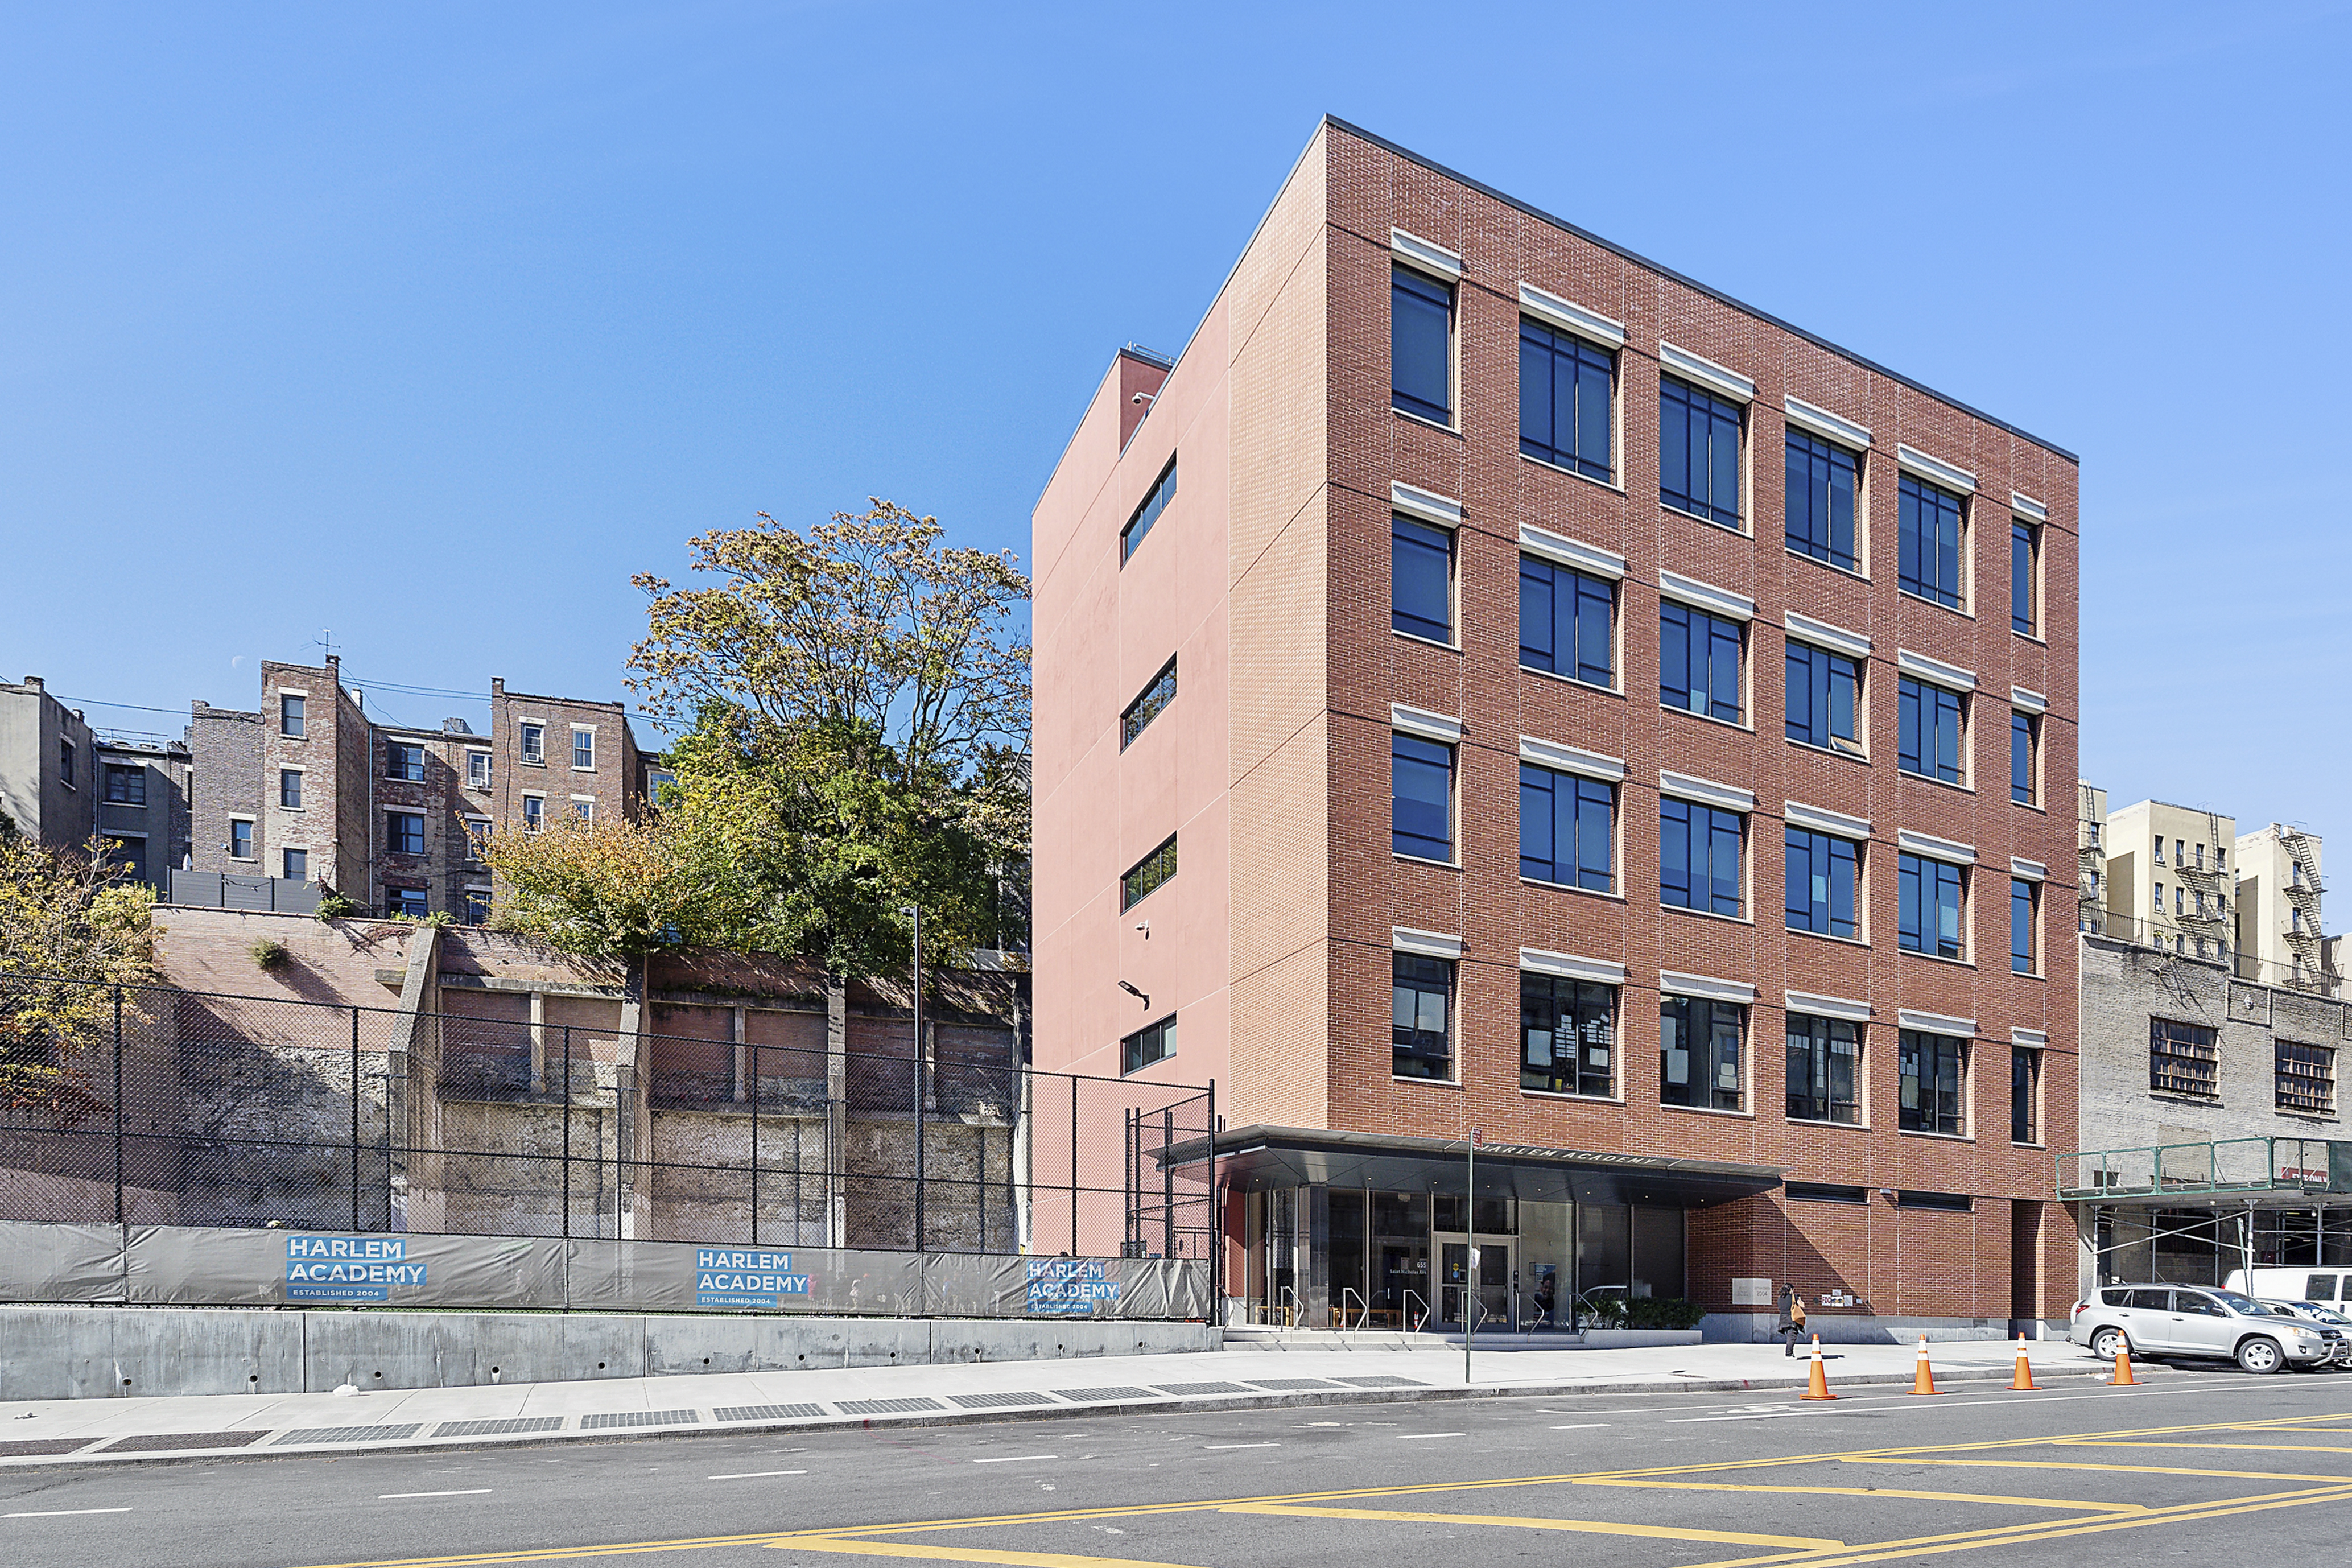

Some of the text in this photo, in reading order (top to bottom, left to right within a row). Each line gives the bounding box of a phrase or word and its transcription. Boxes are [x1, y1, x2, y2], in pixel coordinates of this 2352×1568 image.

[1563, 1152, 1657, 1165] ACADEMY
[290, 1239, 402, 1258] HARLEM
[699, 1252, 789, 1270] HARLEM
[1029, 1262, 1102, 1278] HARLEM
[289, 1264, 424, 1282] ACADEMY
[699, 1274, 807, 1292] ACADEMY
[1029, 1282, 1118, 1298] ACADEMY
